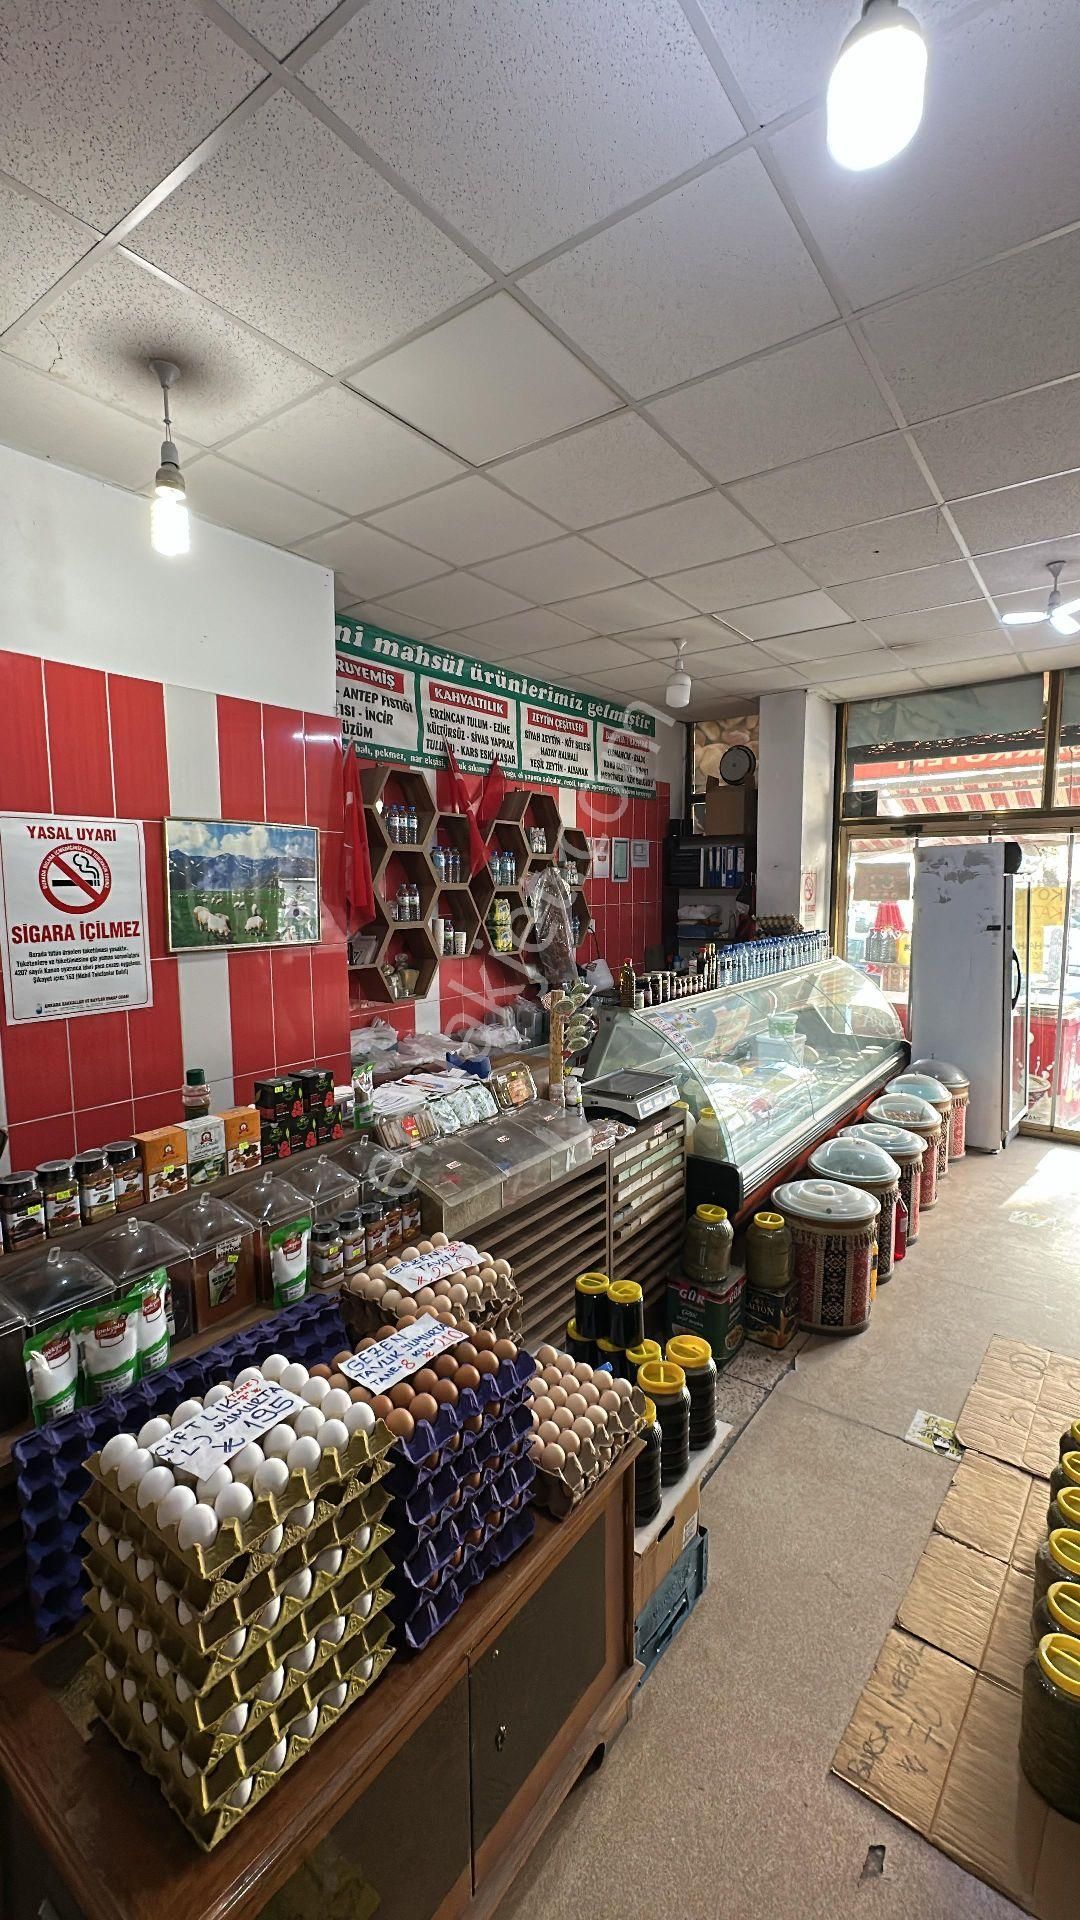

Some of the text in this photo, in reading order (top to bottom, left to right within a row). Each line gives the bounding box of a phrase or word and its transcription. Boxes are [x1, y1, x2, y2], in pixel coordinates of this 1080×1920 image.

[373, 637, 464, 678] mahsül
[470, 663, 583, 711] ürünlerimiz
[343, 687, 379, 704] ANTEP
[381, 695, 414, 713] FISTIĞI
[434, 687, 504, 714] KAHVALTILIK
[365, 706, 394, 725] İNCİR
[429, 708, 465, 726] ERZİNCAN
[467, 716, 488, 730] TULUM
[493, 721, 511, 735] EZİNE
[531, 712, 554, 727] ZEYTİN
[342, 719, 373, 739] ÜZÜM
[427, 722, 465, 741] KÜLTÜRSÜZ
[470, 731, 490, 745] SİVAS
[490, 736, 515, 750] YAPRAK
[461, 746, 479, 758] KARS
[480, 749, 494, 760] ESKİ
[26, 825, 117, 842] YASAL UYARI
[11, 920, 141, 944] SİGARA İÇİLMEZ
[14, 968, 28, 976] 4207
[346, 1333, 408, 1372] GEZEN
[354, 1350, 404, 1380] TAVUK
[242, 1395, 295, 1430] 195
